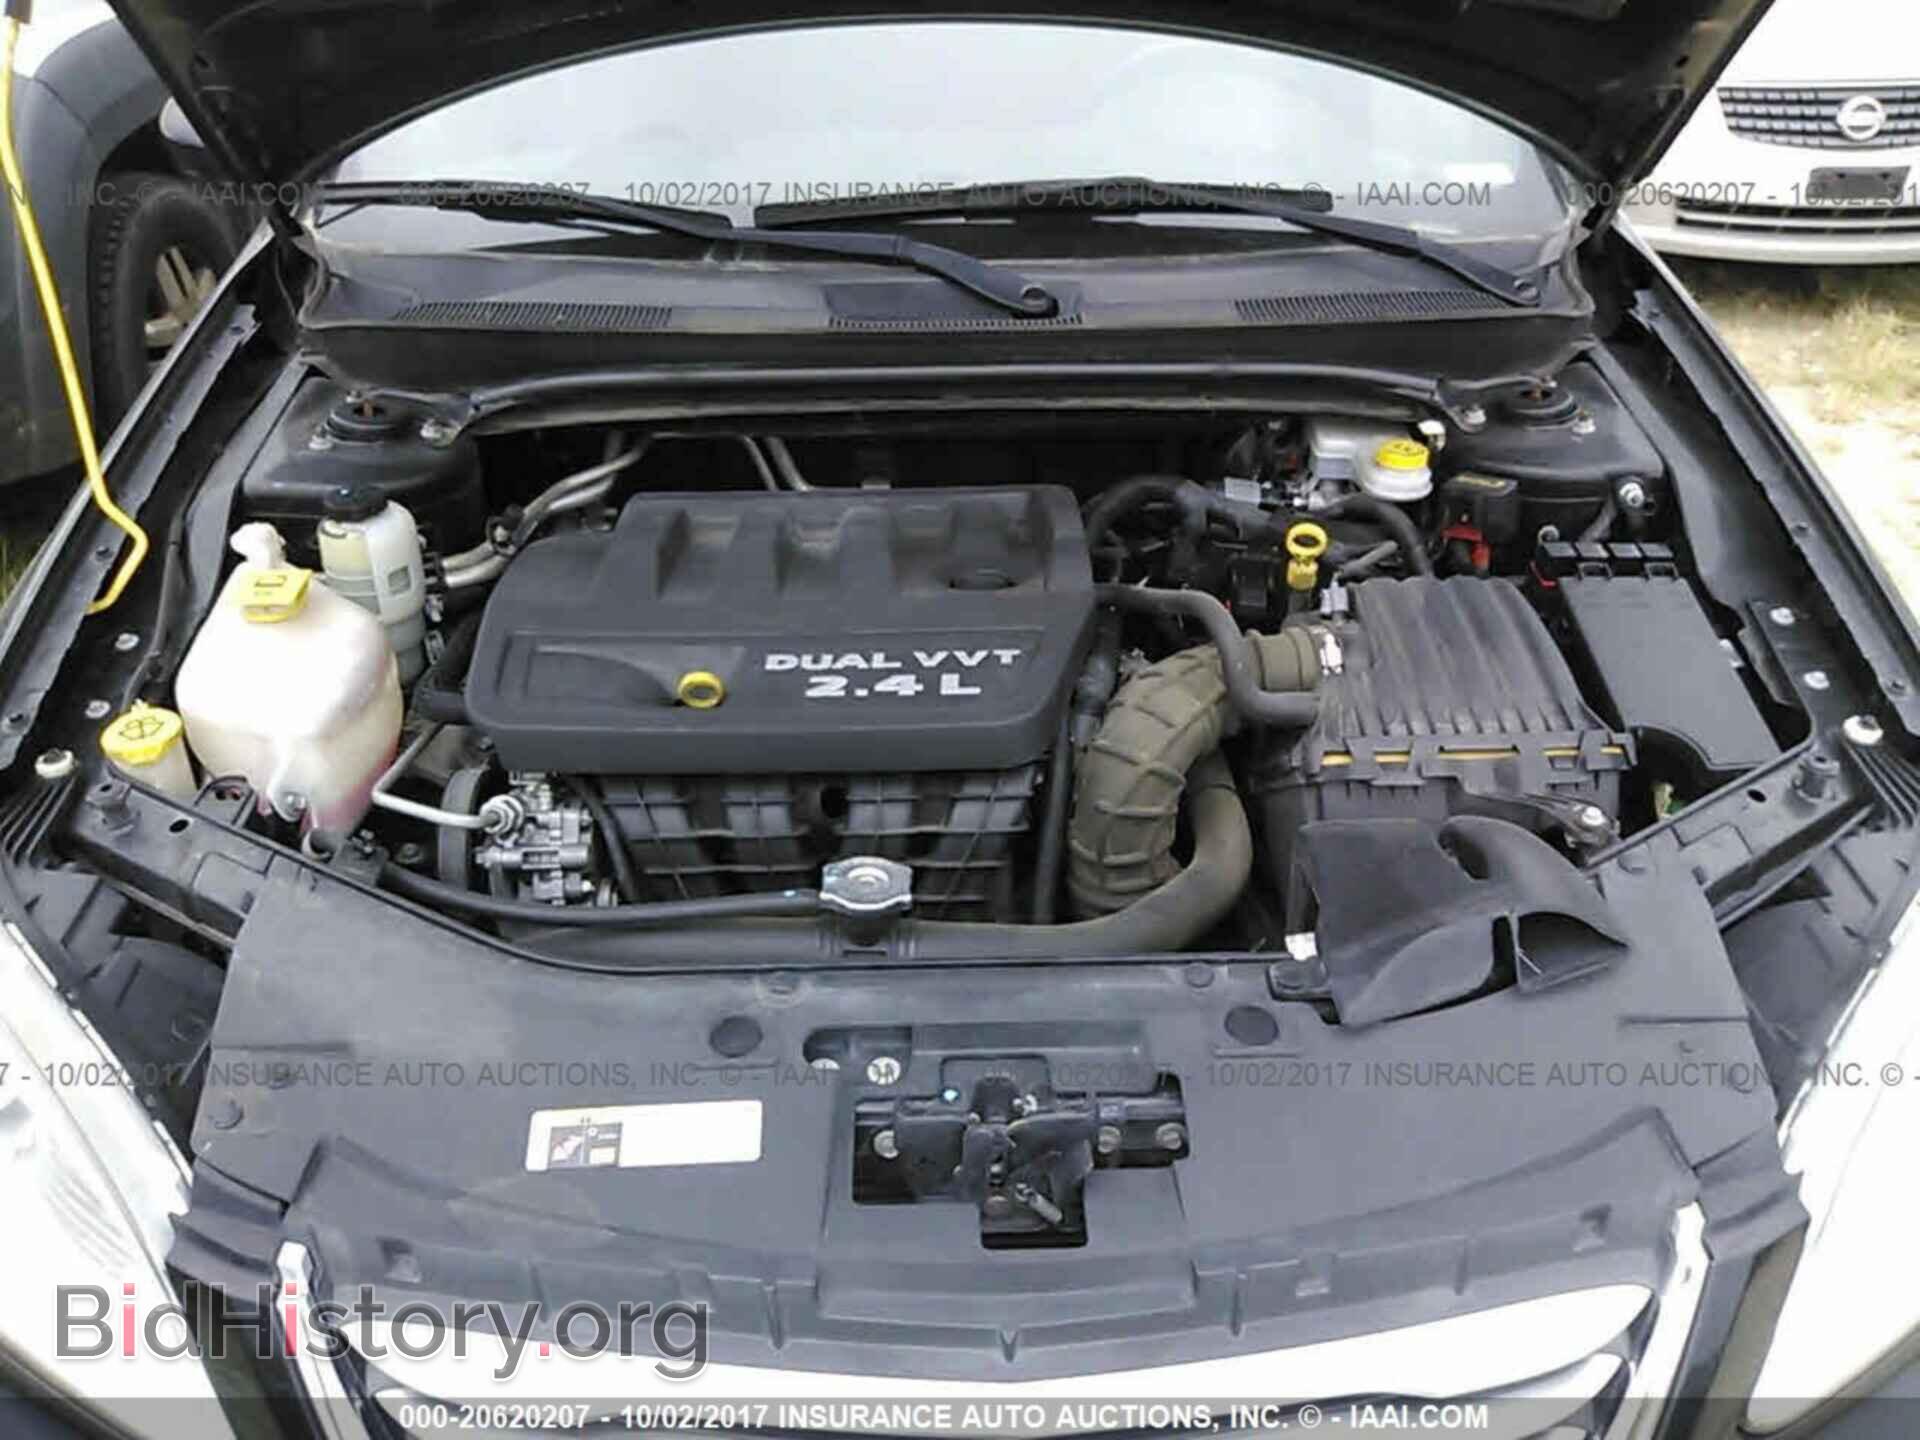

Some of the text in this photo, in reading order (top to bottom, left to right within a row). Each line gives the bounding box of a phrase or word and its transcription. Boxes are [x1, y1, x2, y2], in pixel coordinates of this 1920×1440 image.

[764, 649, 1021, 670] DUAL VVT
[805, 673, 982, 697] 2.4 L
